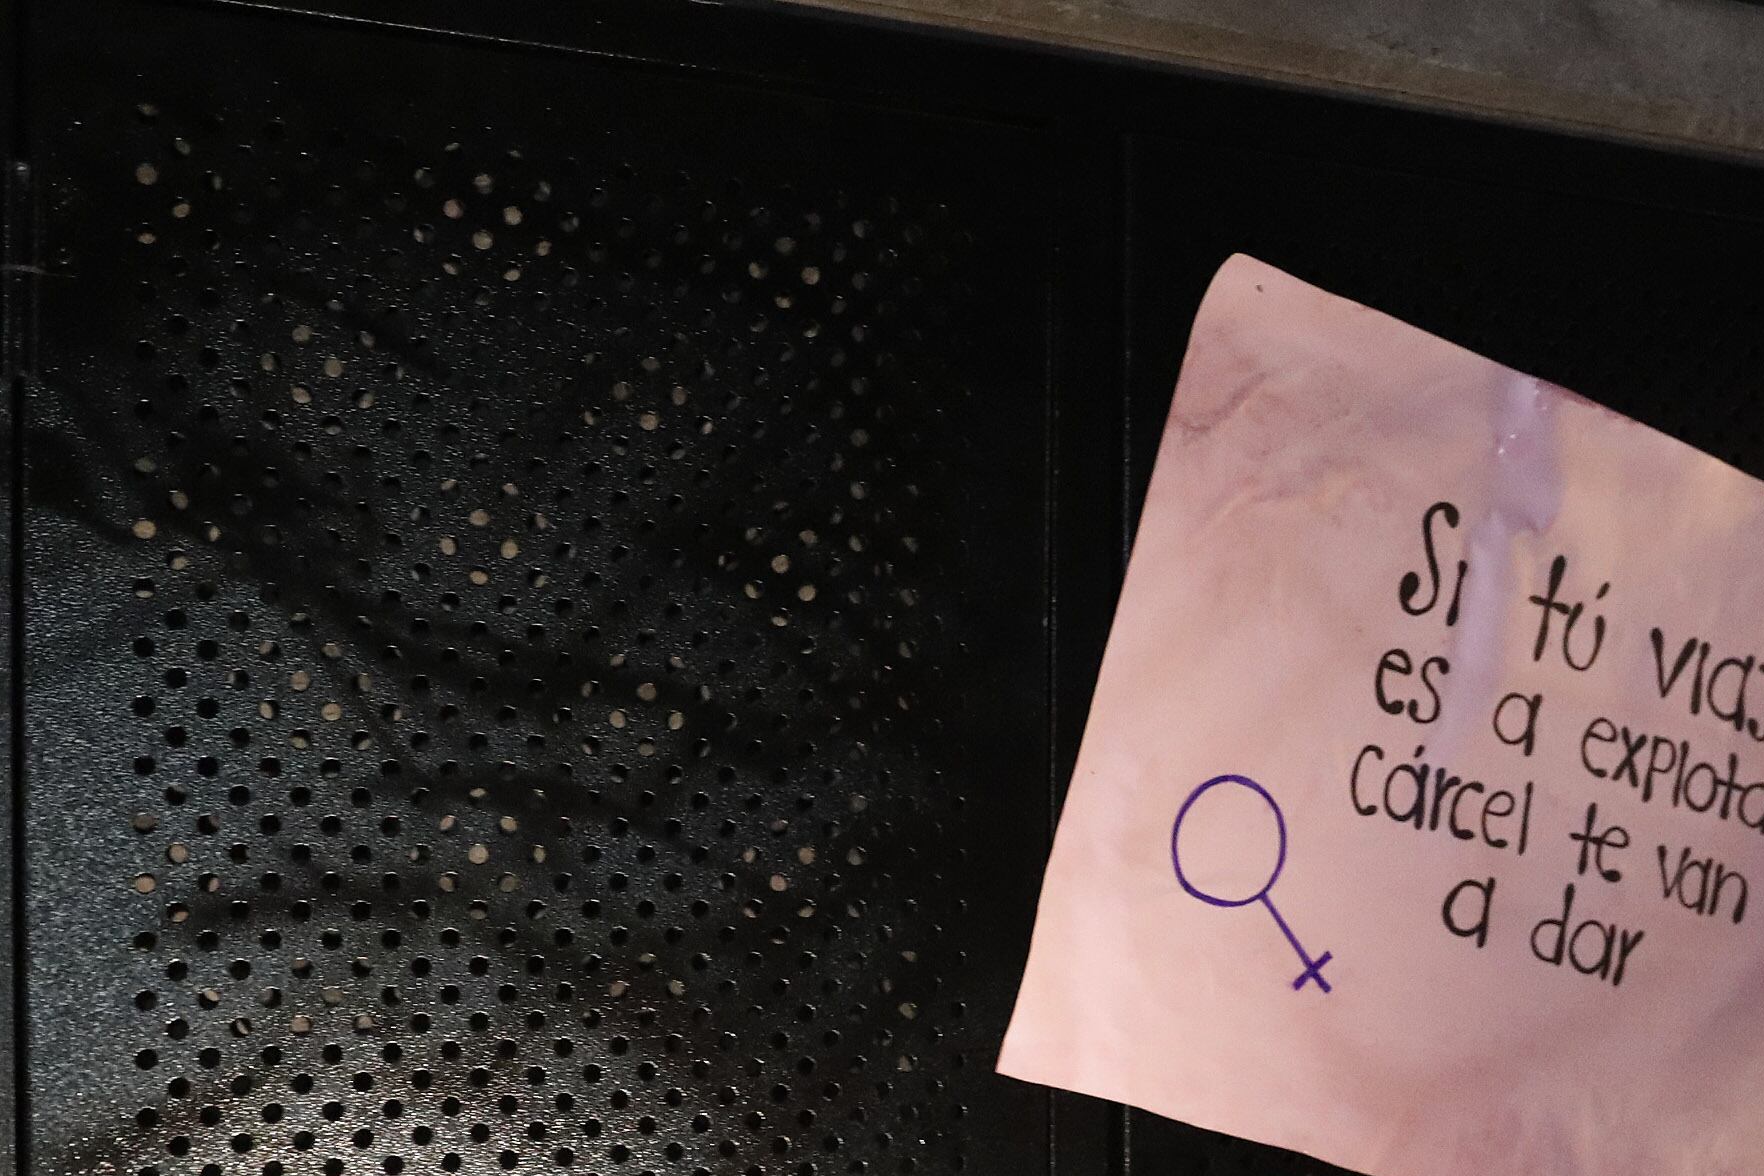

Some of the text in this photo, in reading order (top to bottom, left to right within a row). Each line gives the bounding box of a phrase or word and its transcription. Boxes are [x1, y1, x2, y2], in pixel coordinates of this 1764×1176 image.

[1528, 555, 1612, 671] tú
[1374, 647, 1450, 724] es
[1492, 691, 1544, 756] a
[1569, 802, 1631, 883] te
[1656, 844, 1749, 925] van
[1441, 876, 1645, 986] a dar
